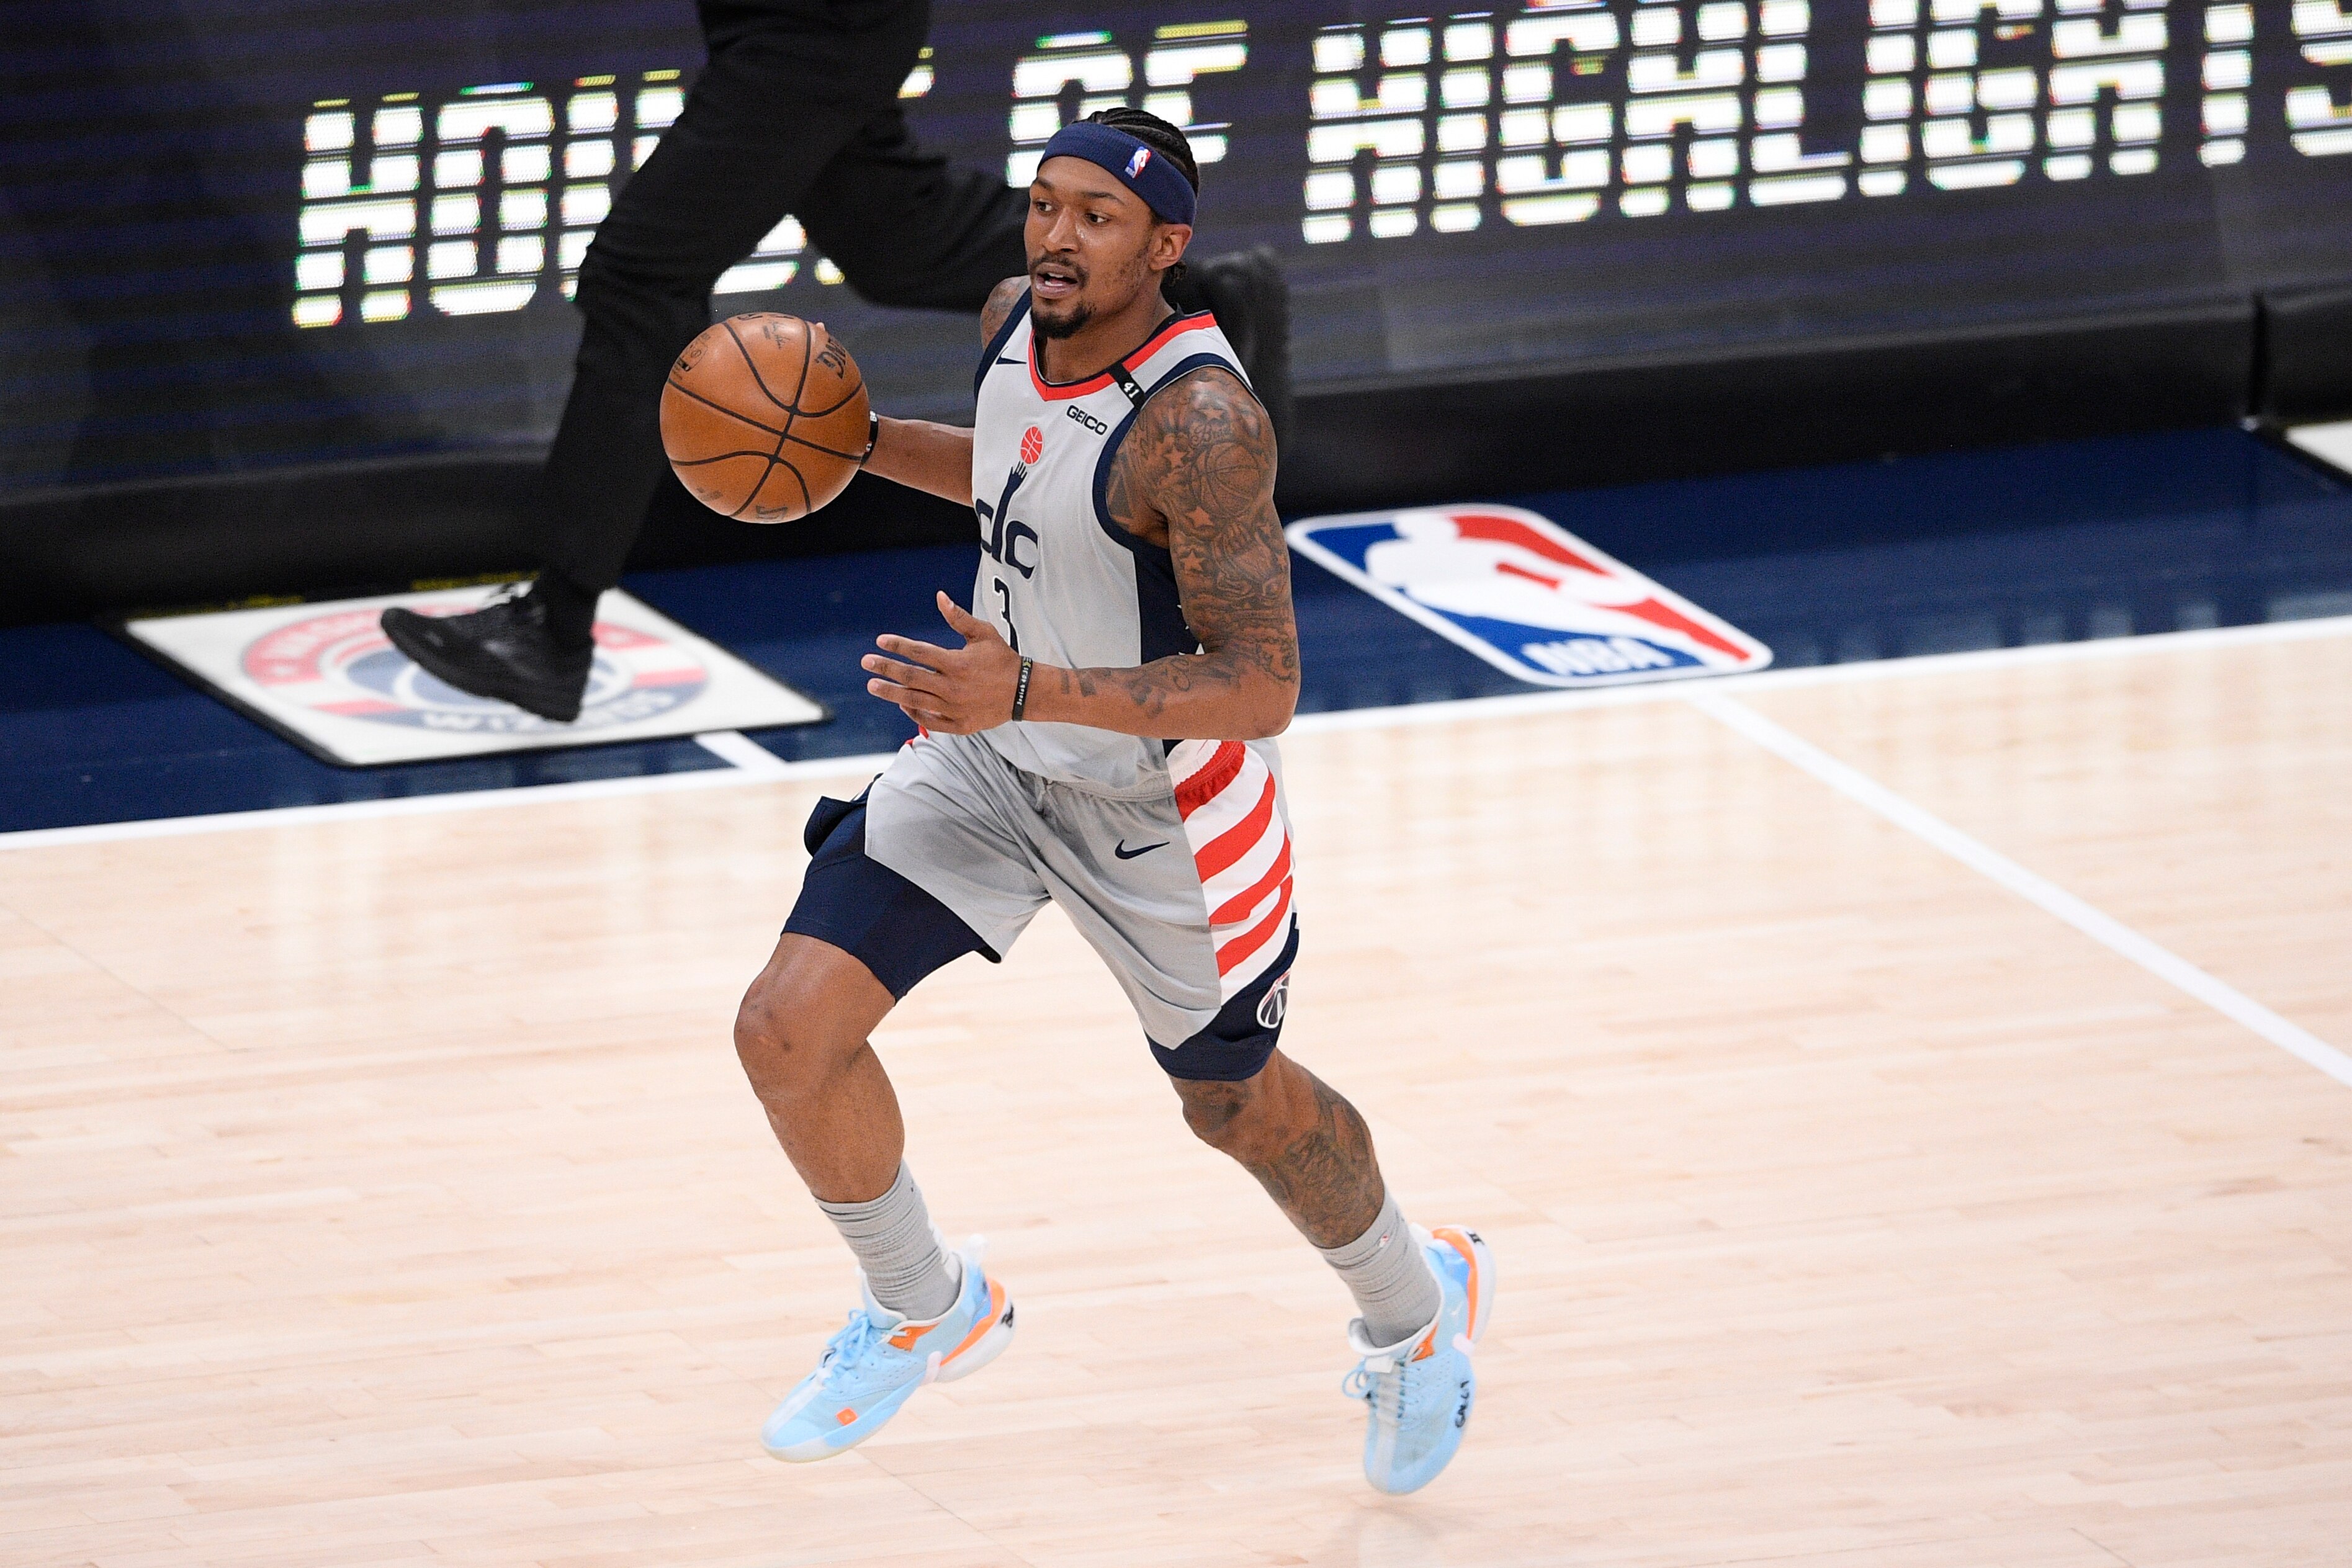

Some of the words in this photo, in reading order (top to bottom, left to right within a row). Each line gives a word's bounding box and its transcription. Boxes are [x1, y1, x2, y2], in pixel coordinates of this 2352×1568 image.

[1124, 382, 1139, 399] 41
[1066, 404, 1108, 436] GEICO
[1522, 638, 1675, 676] NBA
